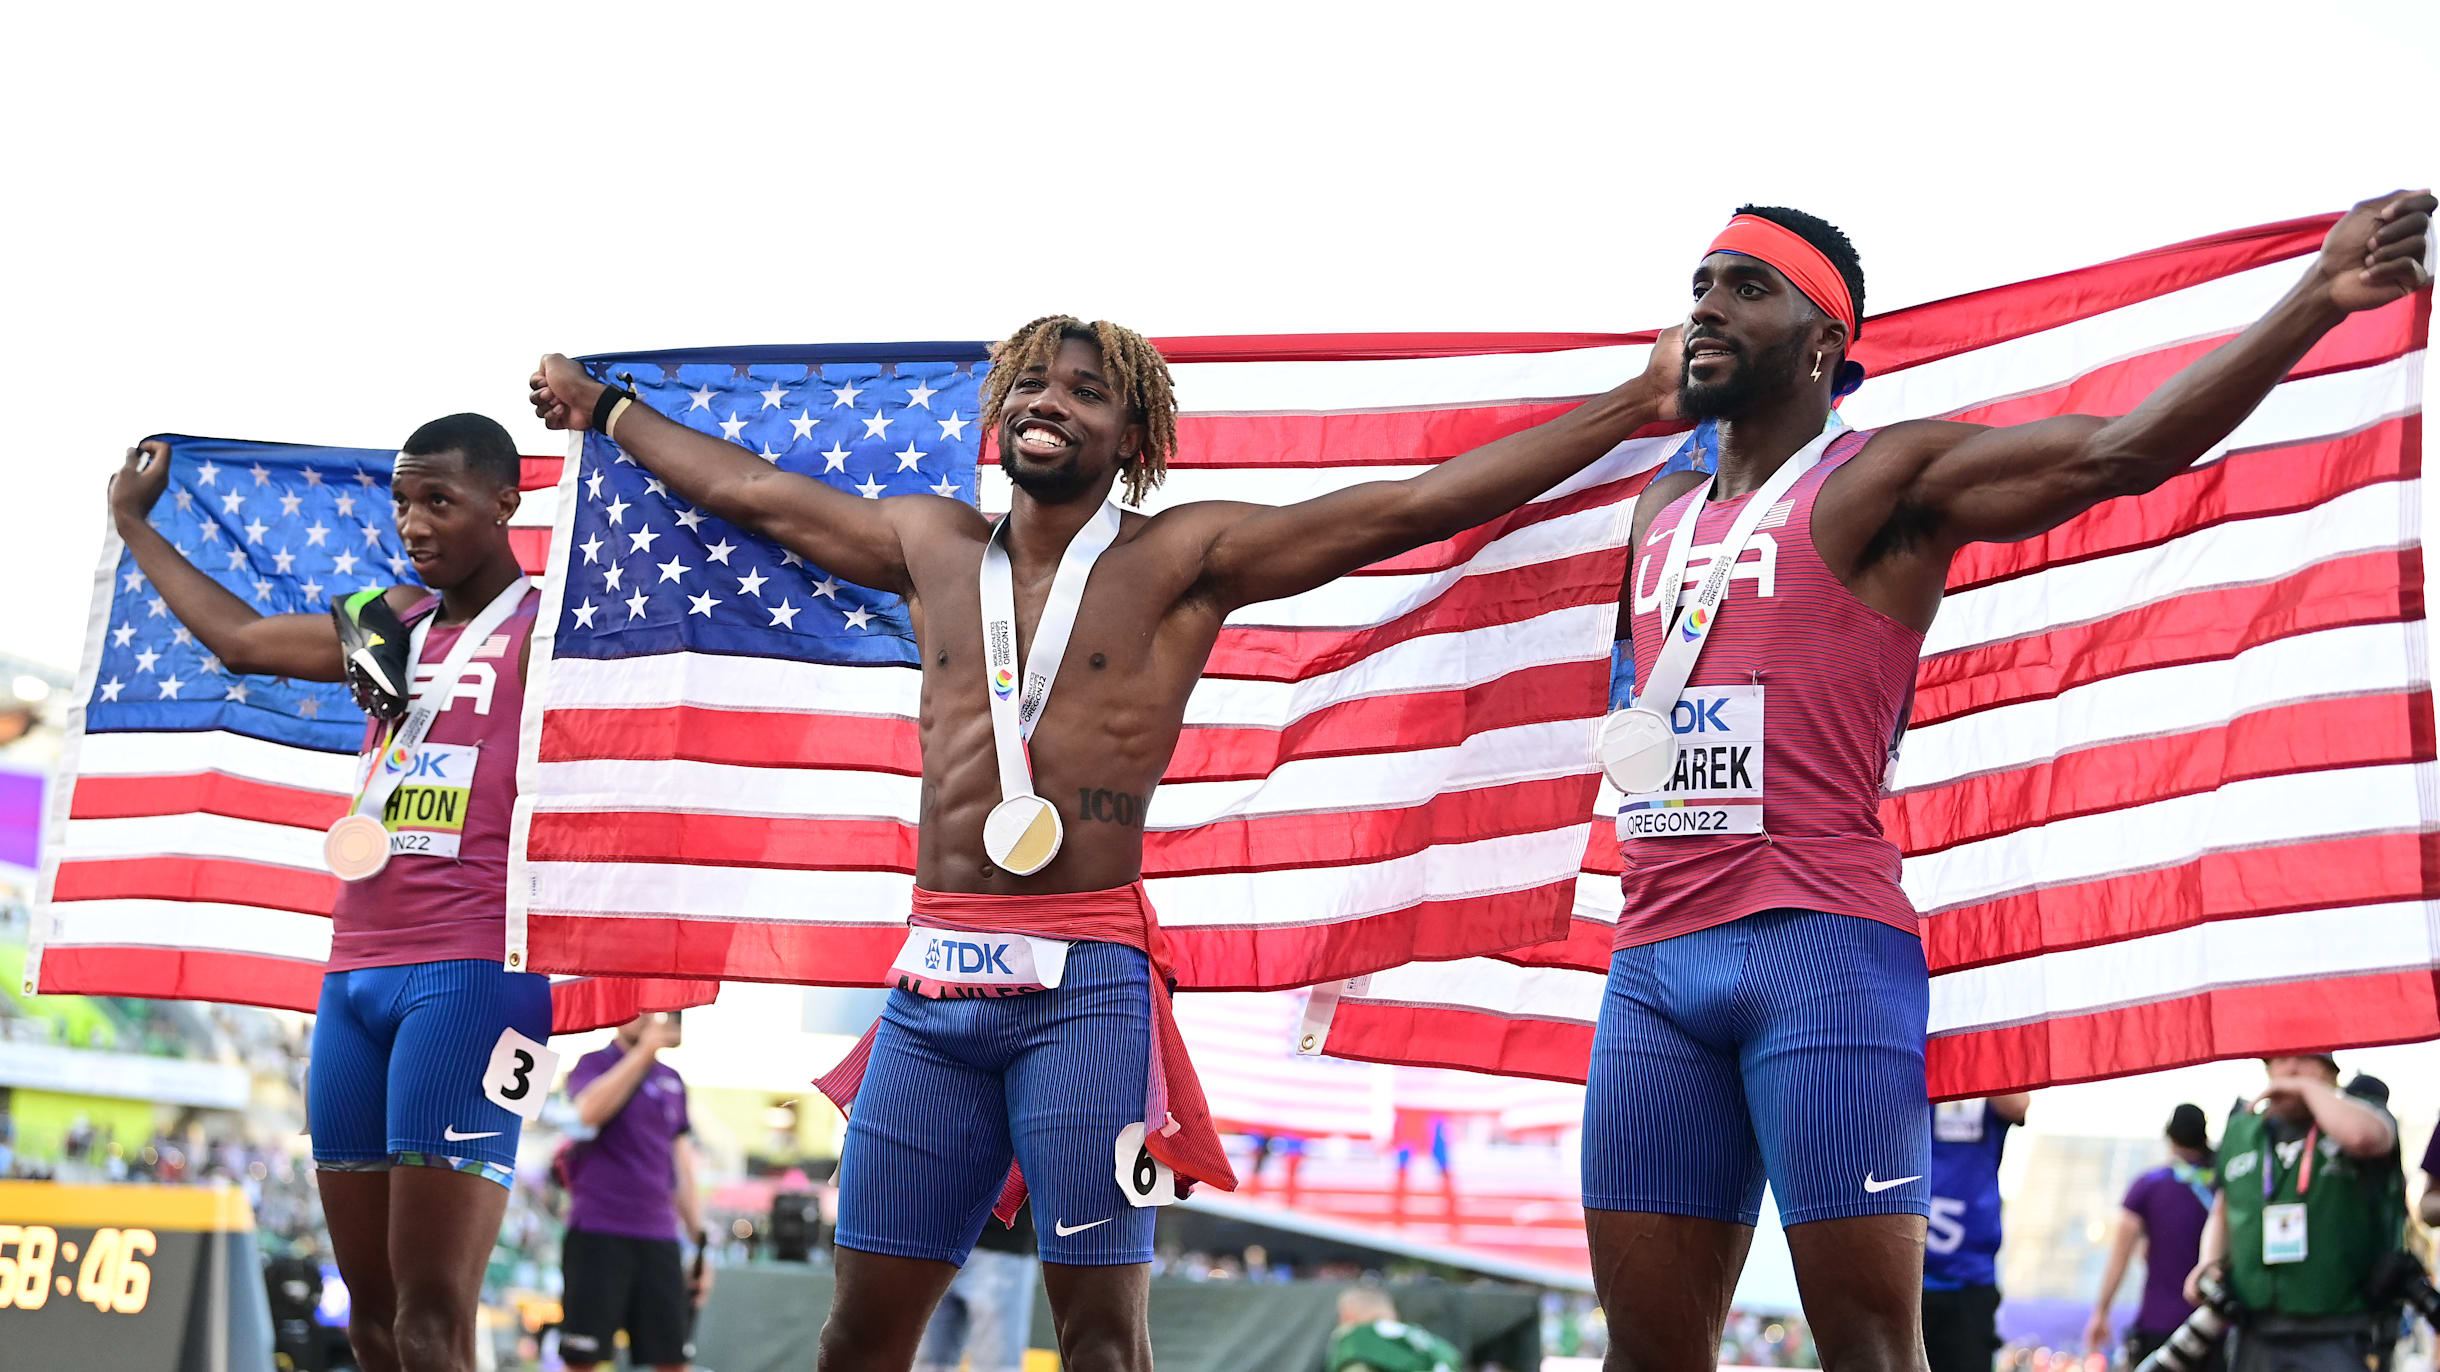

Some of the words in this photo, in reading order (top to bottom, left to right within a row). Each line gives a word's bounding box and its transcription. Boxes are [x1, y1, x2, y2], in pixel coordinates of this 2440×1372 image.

[1707, 556, 1732, 606] OREGON22
[1000, 620, 1010, 665] OREGON22
[1024, 675, 1047, 722] OREGON22
[1671, 697, 1732, 735] DK
[1664, 745, 1753, 792] AREK
[384, 788, 459, 823] HTON
[1627, 810, 1729, 835] OREGON22
[391, 835, 431, 851] N22
[941, 940, 1014, 975] TDK
[500, 1048, 535, 1101] 3
[1132, 1143, 1157, 1196] 6
